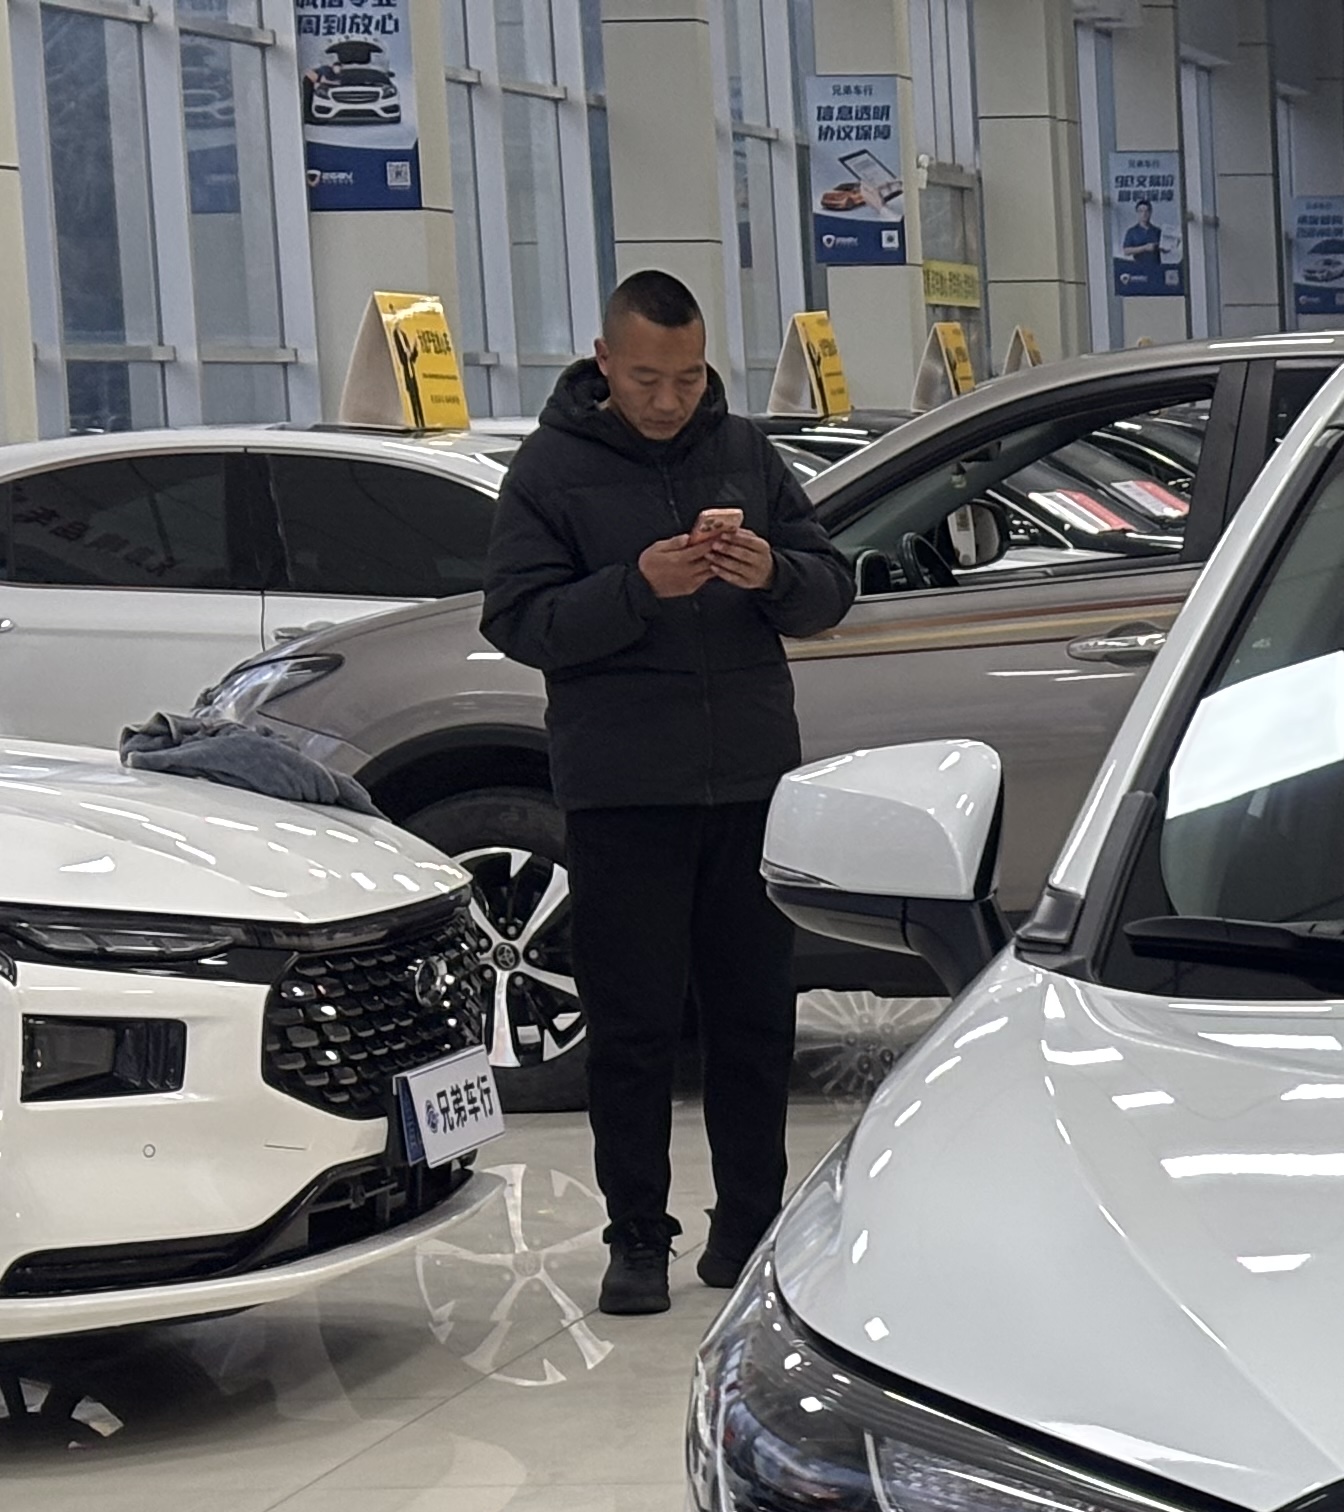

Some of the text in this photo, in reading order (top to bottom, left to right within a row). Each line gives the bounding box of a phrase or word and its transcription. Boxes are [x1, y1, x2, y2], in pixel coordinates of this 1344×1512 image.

[297, 13, 399, 36] 周到放心
[831, 84, 873, 96] 兄弟车行
[816, 104, 891, 122] 信息透明
[817, 124, 891, 142] 协议保障
[436, 1074, 494, 1134] 兄弟车行
